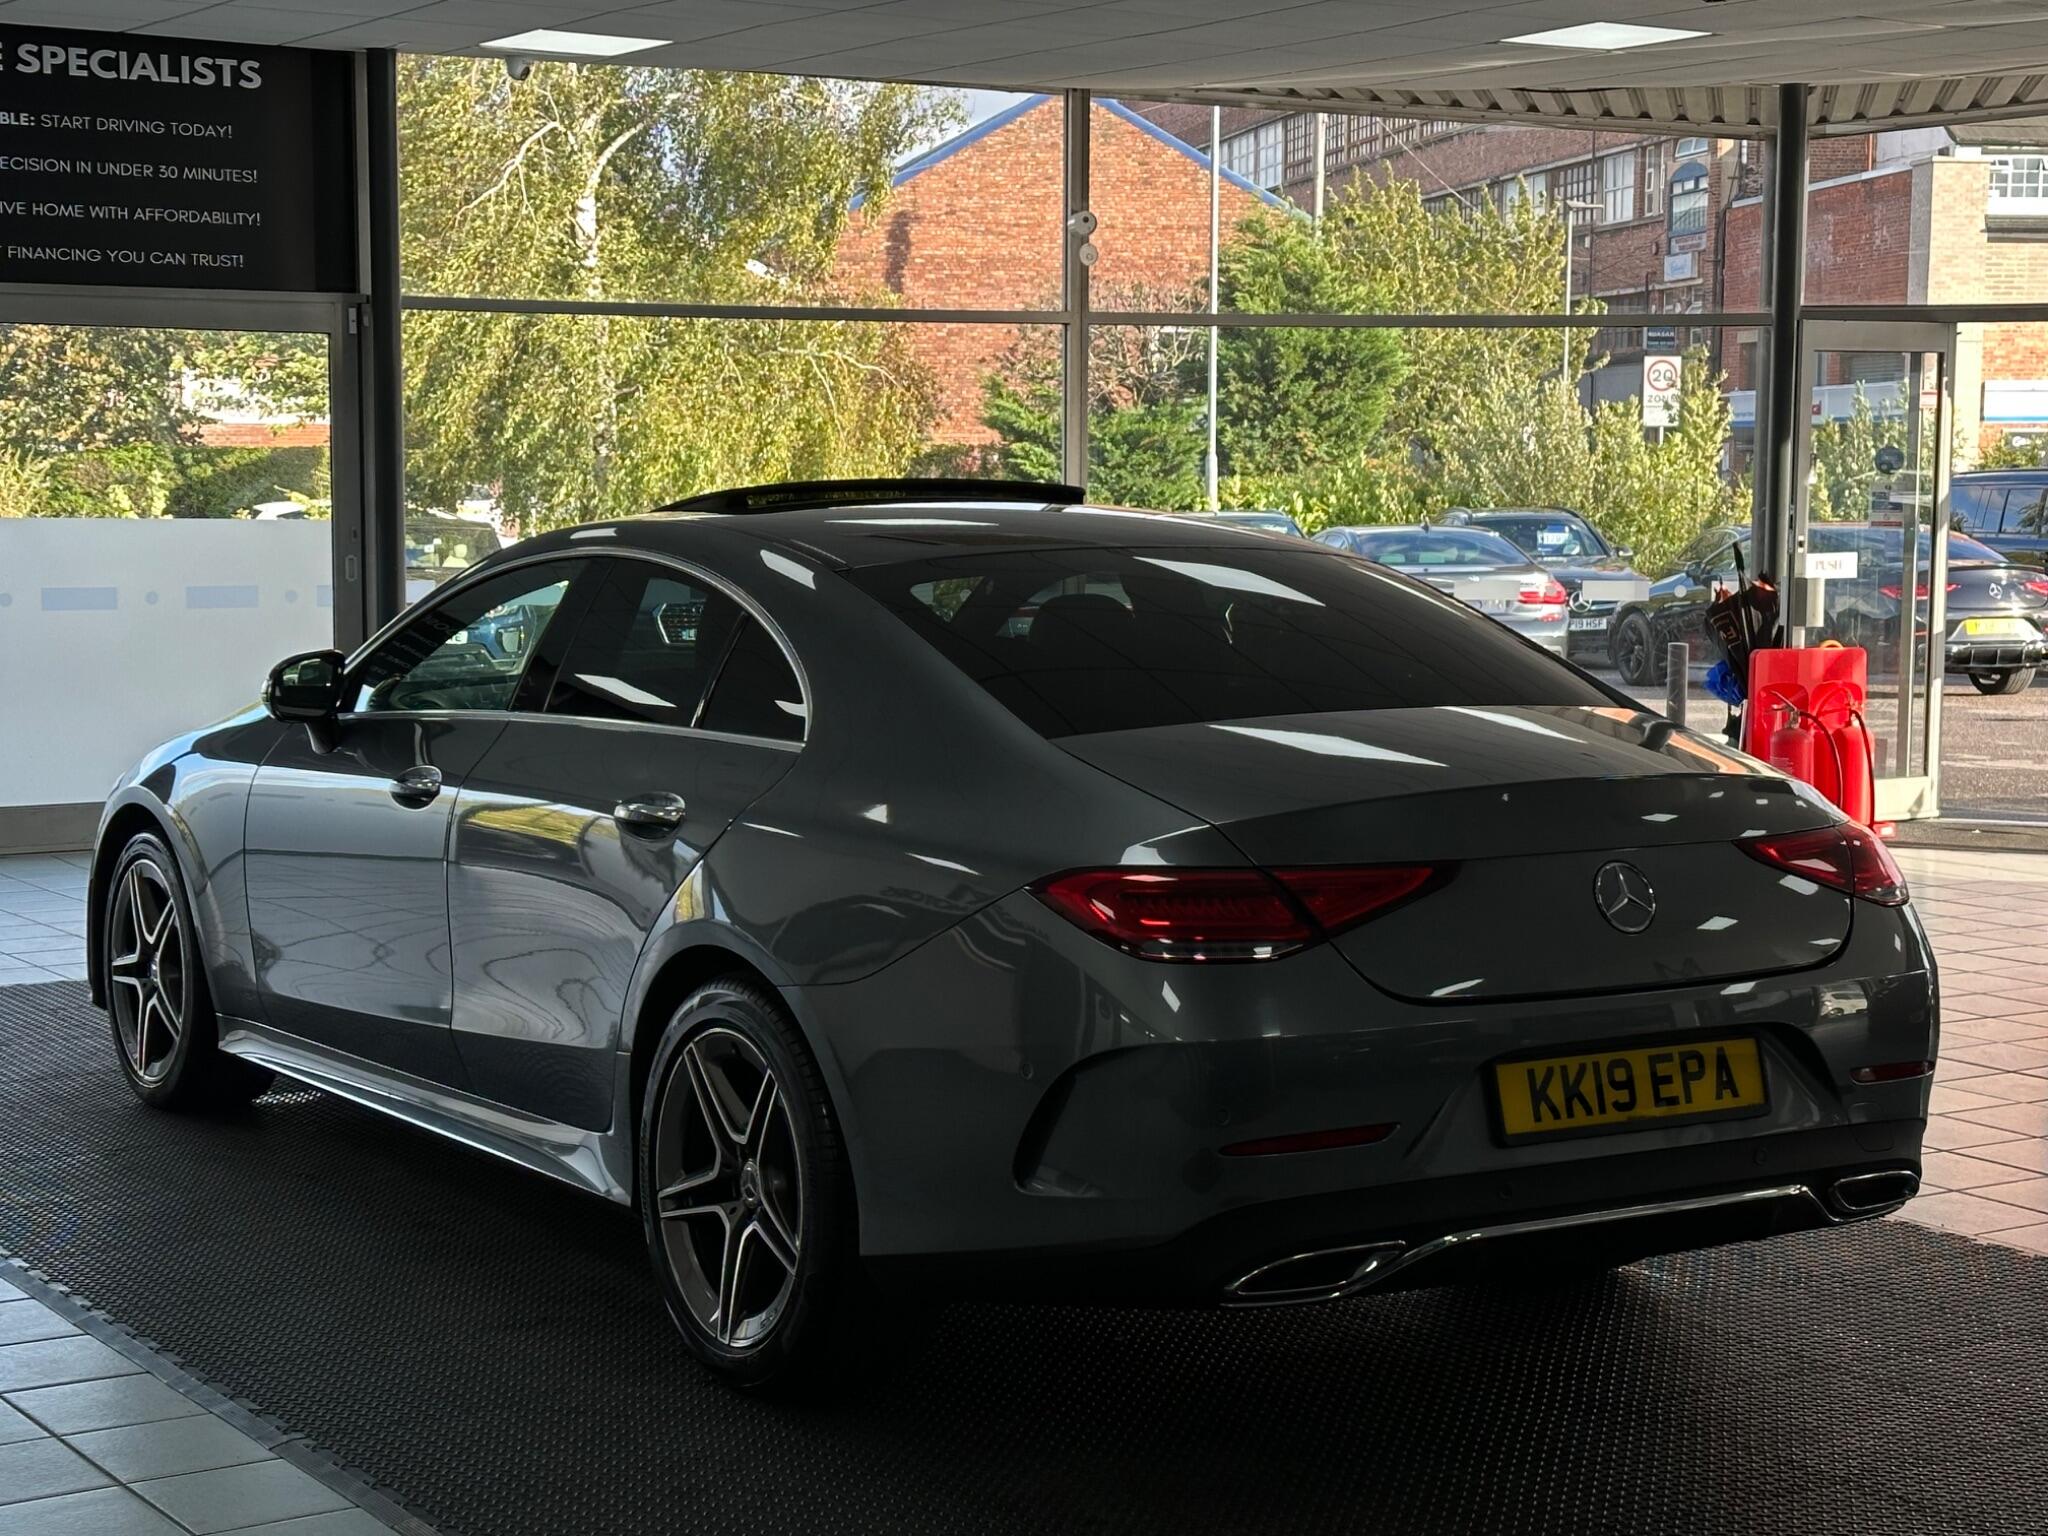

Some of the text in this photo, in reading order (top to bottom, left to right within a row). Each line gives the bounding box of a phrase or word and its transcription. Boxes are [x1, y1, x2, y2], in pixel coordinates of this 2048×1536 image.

[15, 43, 262, 89] SPECIALISTS
[0, 111, 232, 139] BLE: START DRIVING TODAY!
[0, 156, 257, 184] ECISION IN UNDER 30 MINUTES!
[32, 202, 85, 218] HOME
[89, 205, 128, 220] WITH
[133, 207, 260, 226] AFFORDABILITY!
[7, 245, 244, 268] FINANCING YOU CAN TRUST!
[1652, 369, 1673, 382] 20
[1526, 1046, 1740, 1123] KK19 EPA
